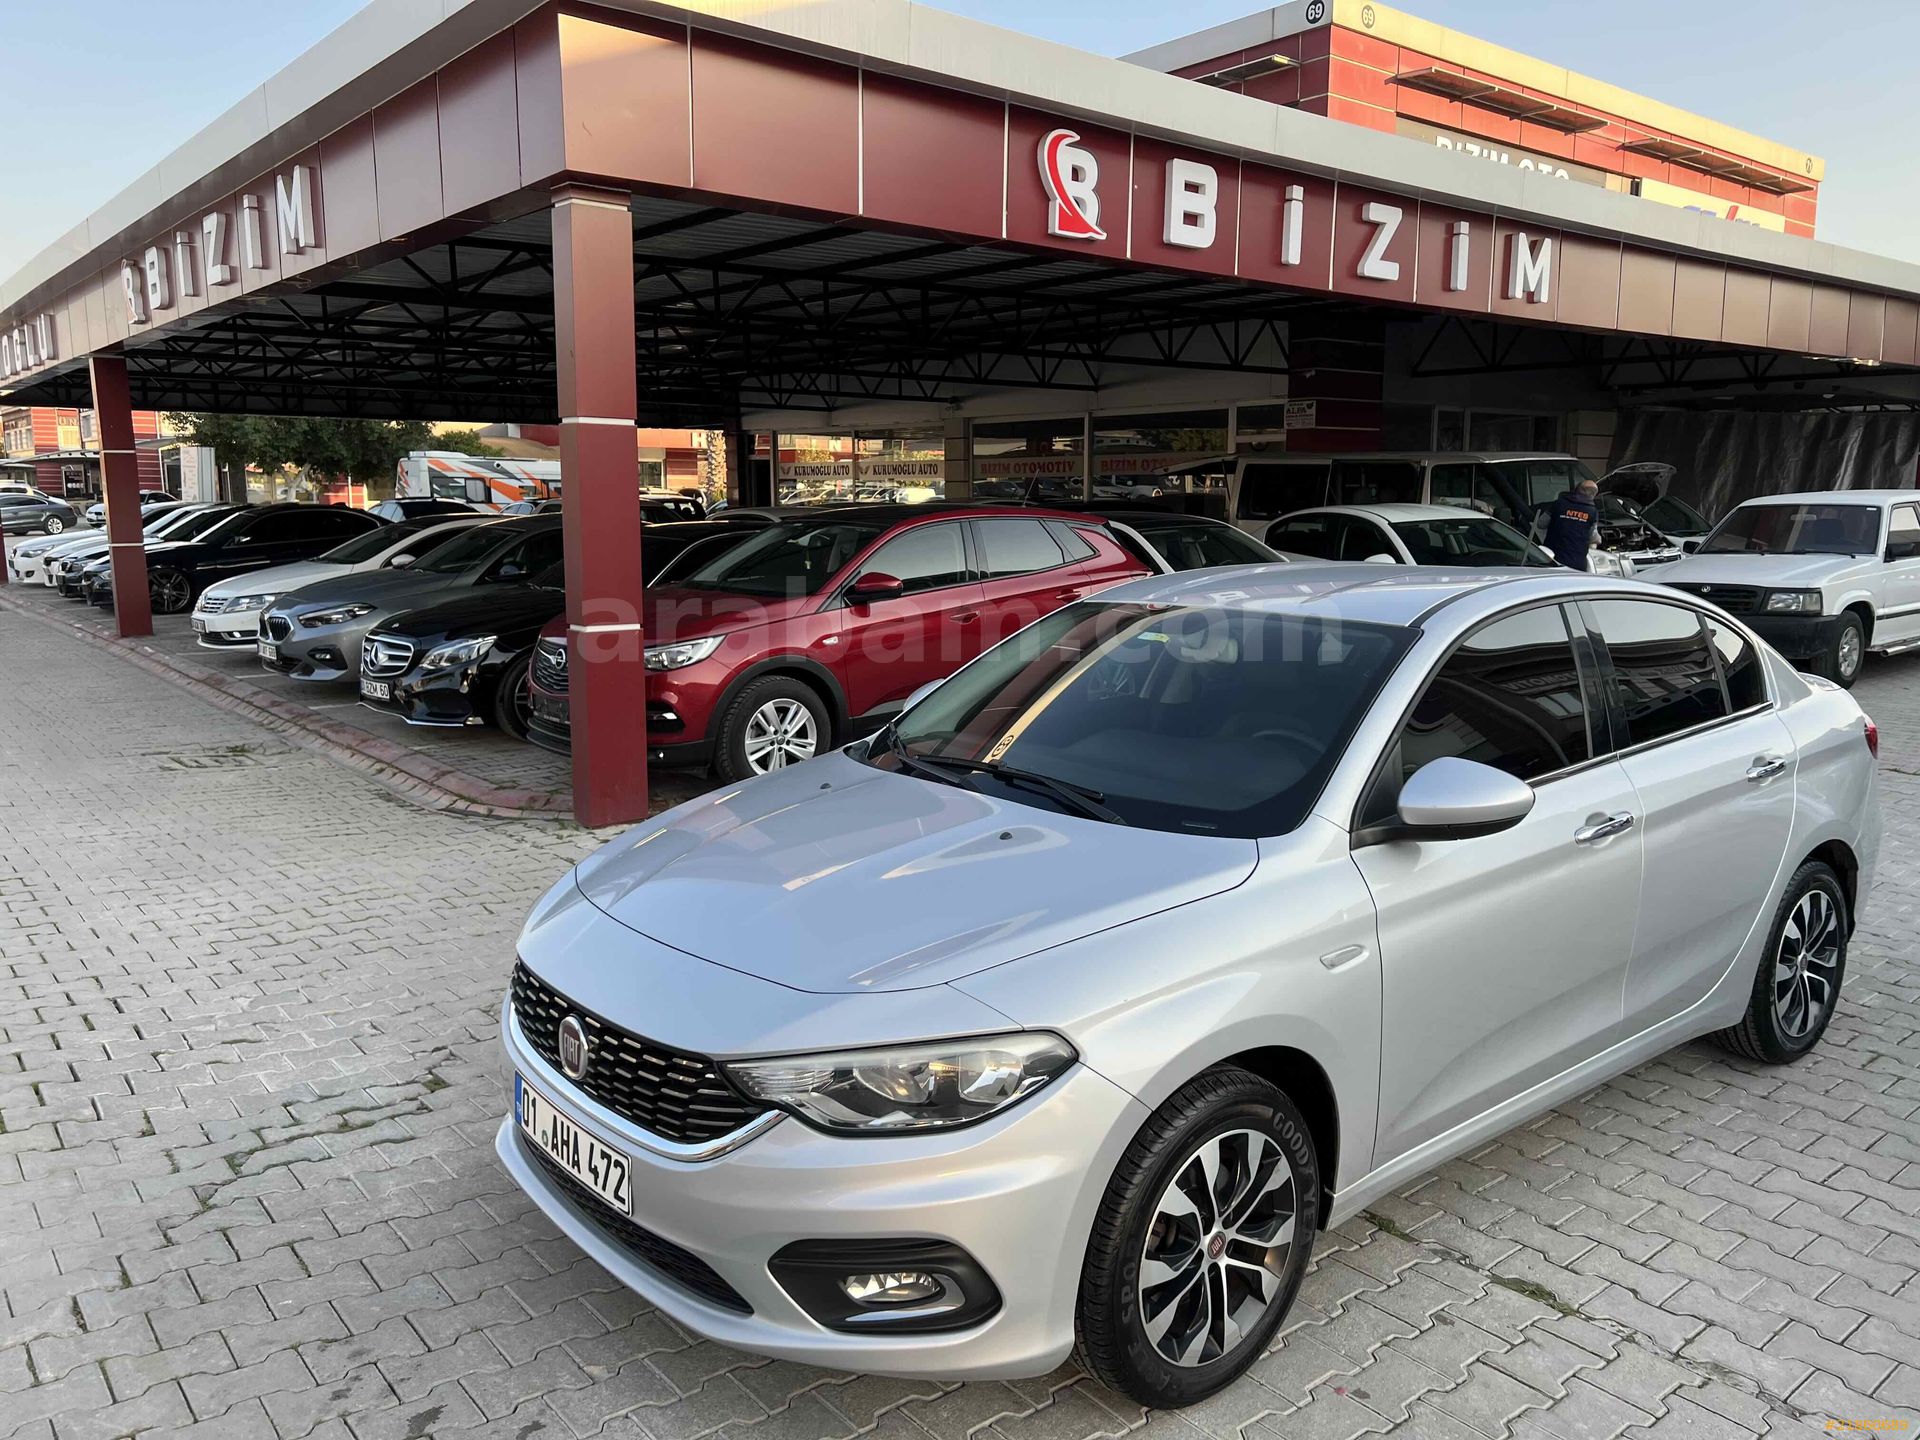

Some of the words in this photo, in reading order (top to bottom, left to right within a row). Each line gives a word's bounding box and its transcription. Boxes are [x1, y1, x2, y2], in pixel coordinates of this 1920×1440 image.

[1307, 3, 1323, 20] 69
[1362, 9, 1374, 25] 69
[563, 1033, 580, 1064] FIAT
[522, 1087, 537, 1135] 01
[551, 1114, 581, 1174] AHA
[588, 1142, 626, 1205] 472
